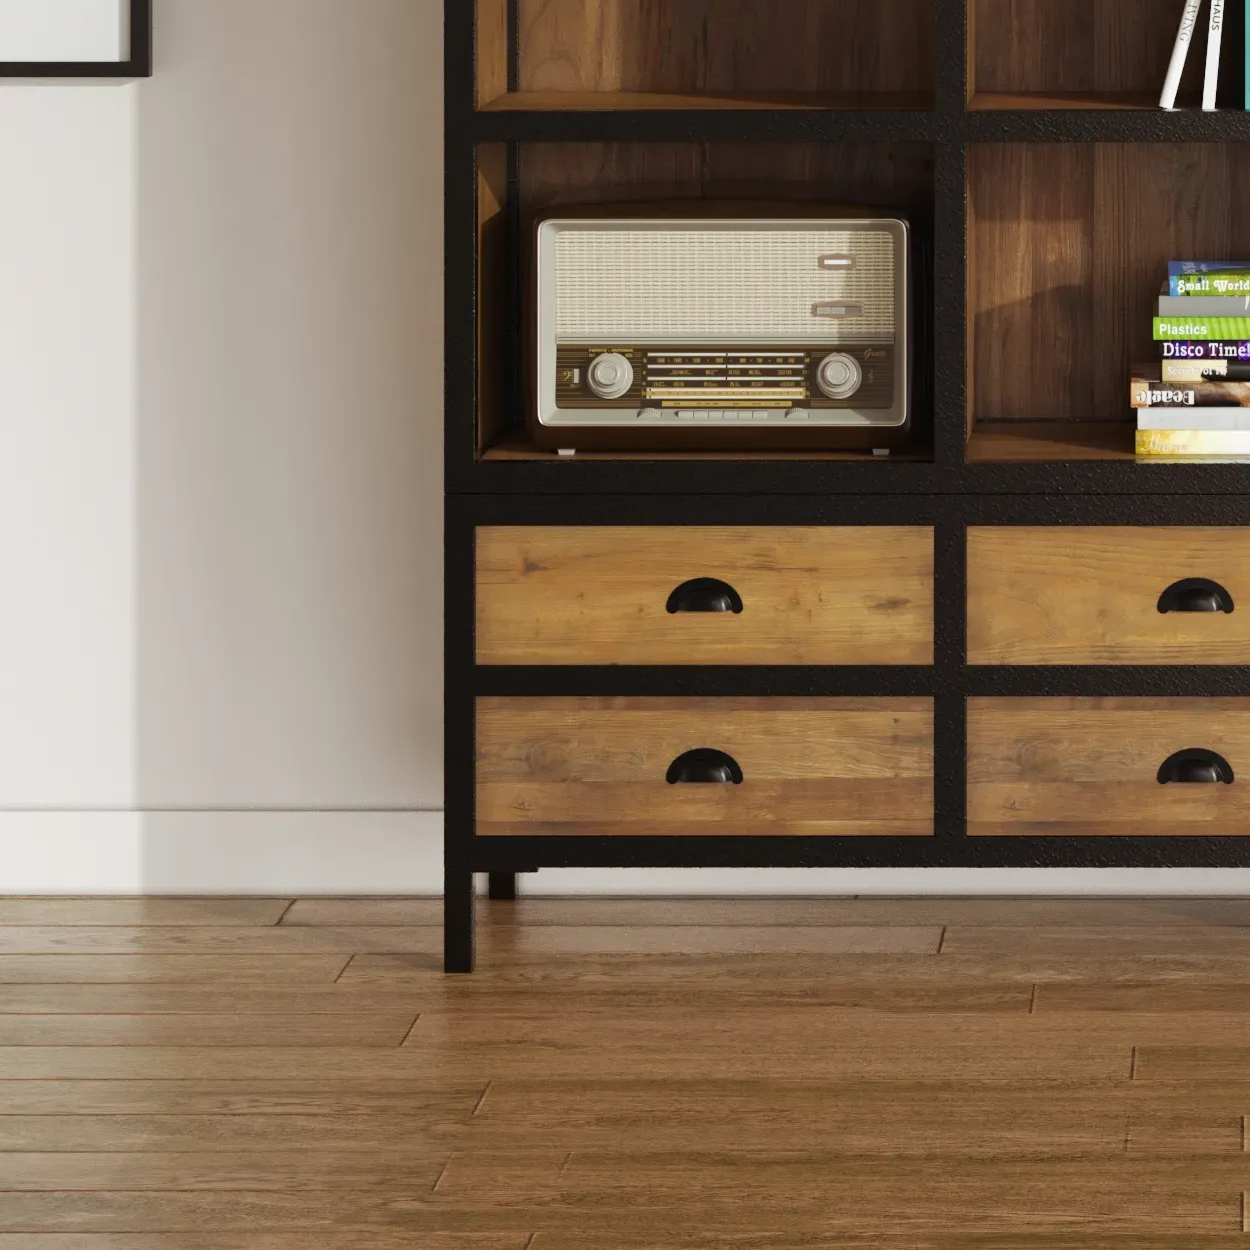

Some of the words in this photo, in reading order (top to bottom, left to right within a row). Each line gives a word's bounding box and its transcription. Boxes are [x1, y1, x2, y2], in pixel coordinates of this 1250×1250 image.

[1176, 279, 1210, 293] Small
[1213, 279, 1250, 292] World
[1159, 323, 1207, 336] Plastics
[1163, 342, 1204, 357] Disco
[1208, 342, 1250, 357] Time!
[1136, 390, 1195, 405] Beagle
